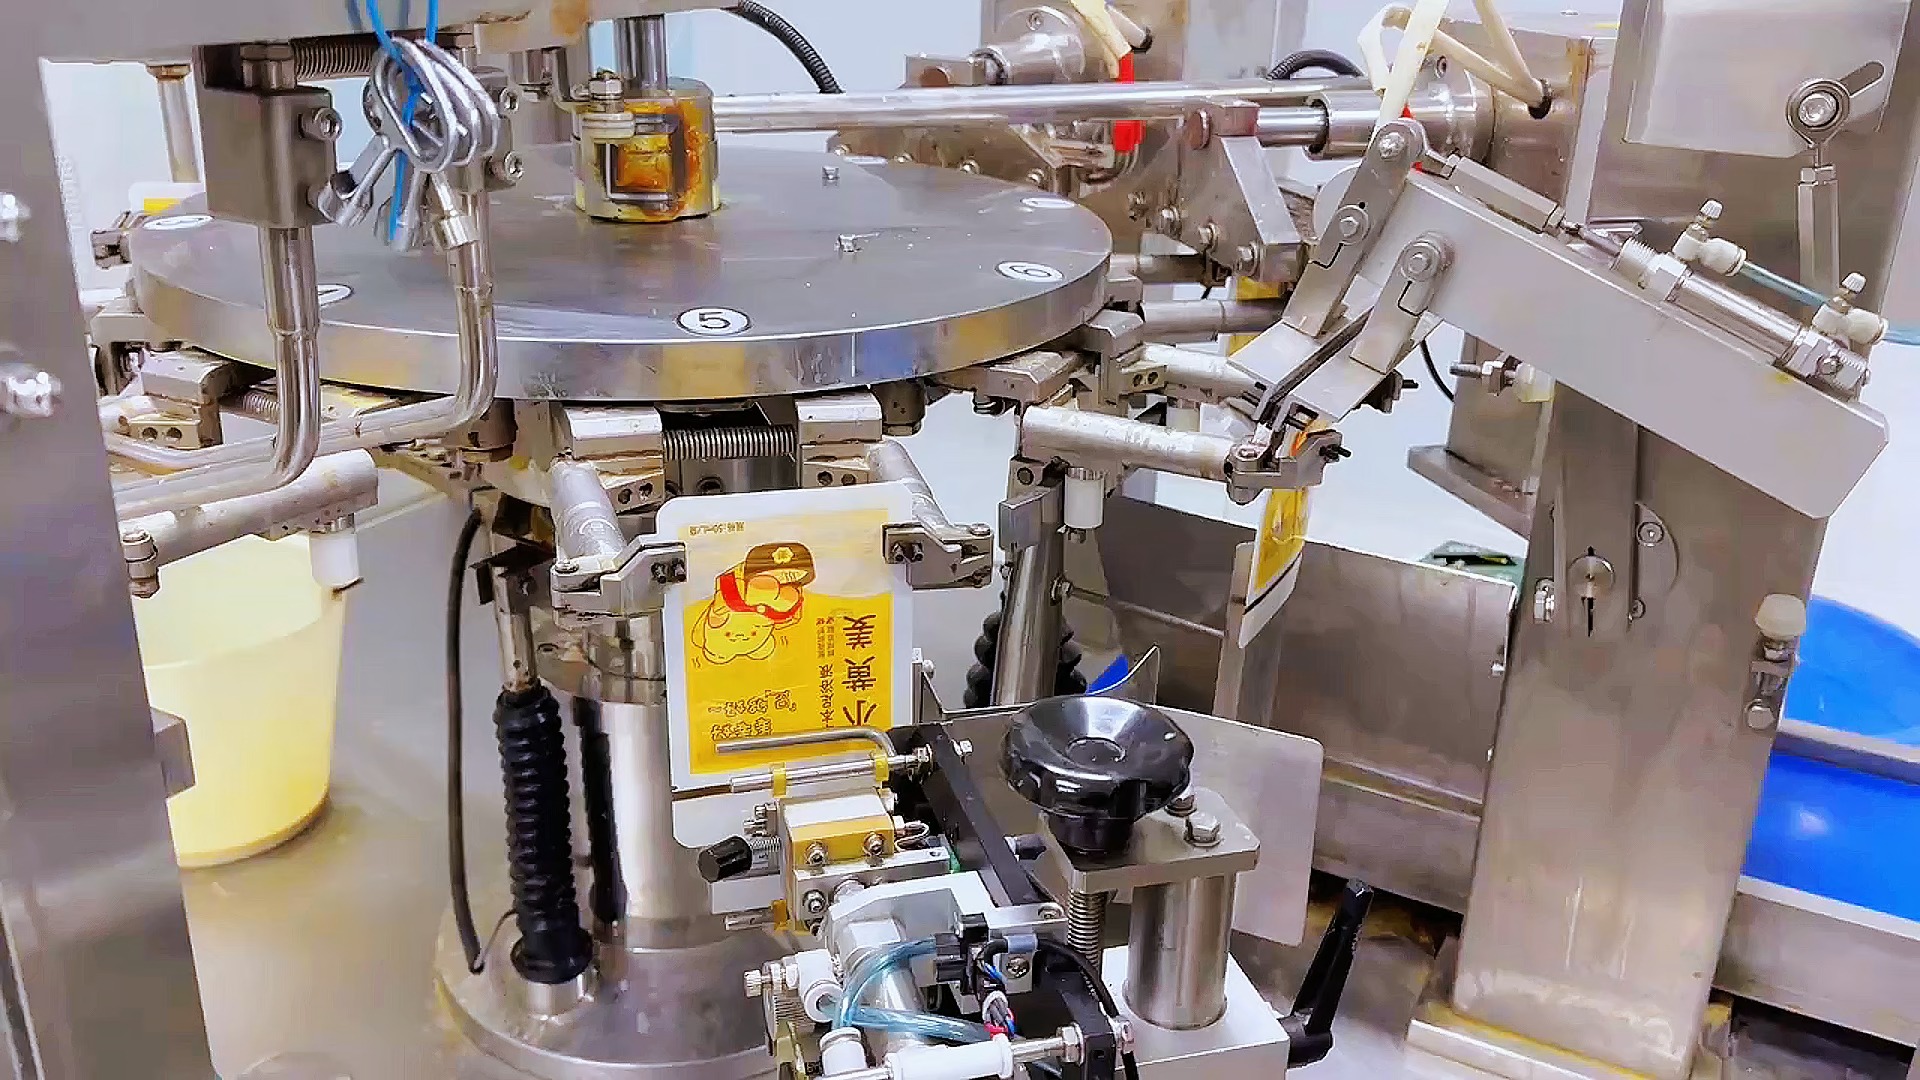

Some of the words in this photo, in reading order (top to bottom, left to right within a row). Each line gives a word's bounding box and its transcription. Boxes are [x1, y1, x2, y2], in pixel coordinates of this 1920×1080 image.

[1009, 265, 1052, 278] 6
[699, 311, 731, 329] 5
[841, 614, 877, 727] 小黄姜
[818, 664, 835, 729] 本足浴液
